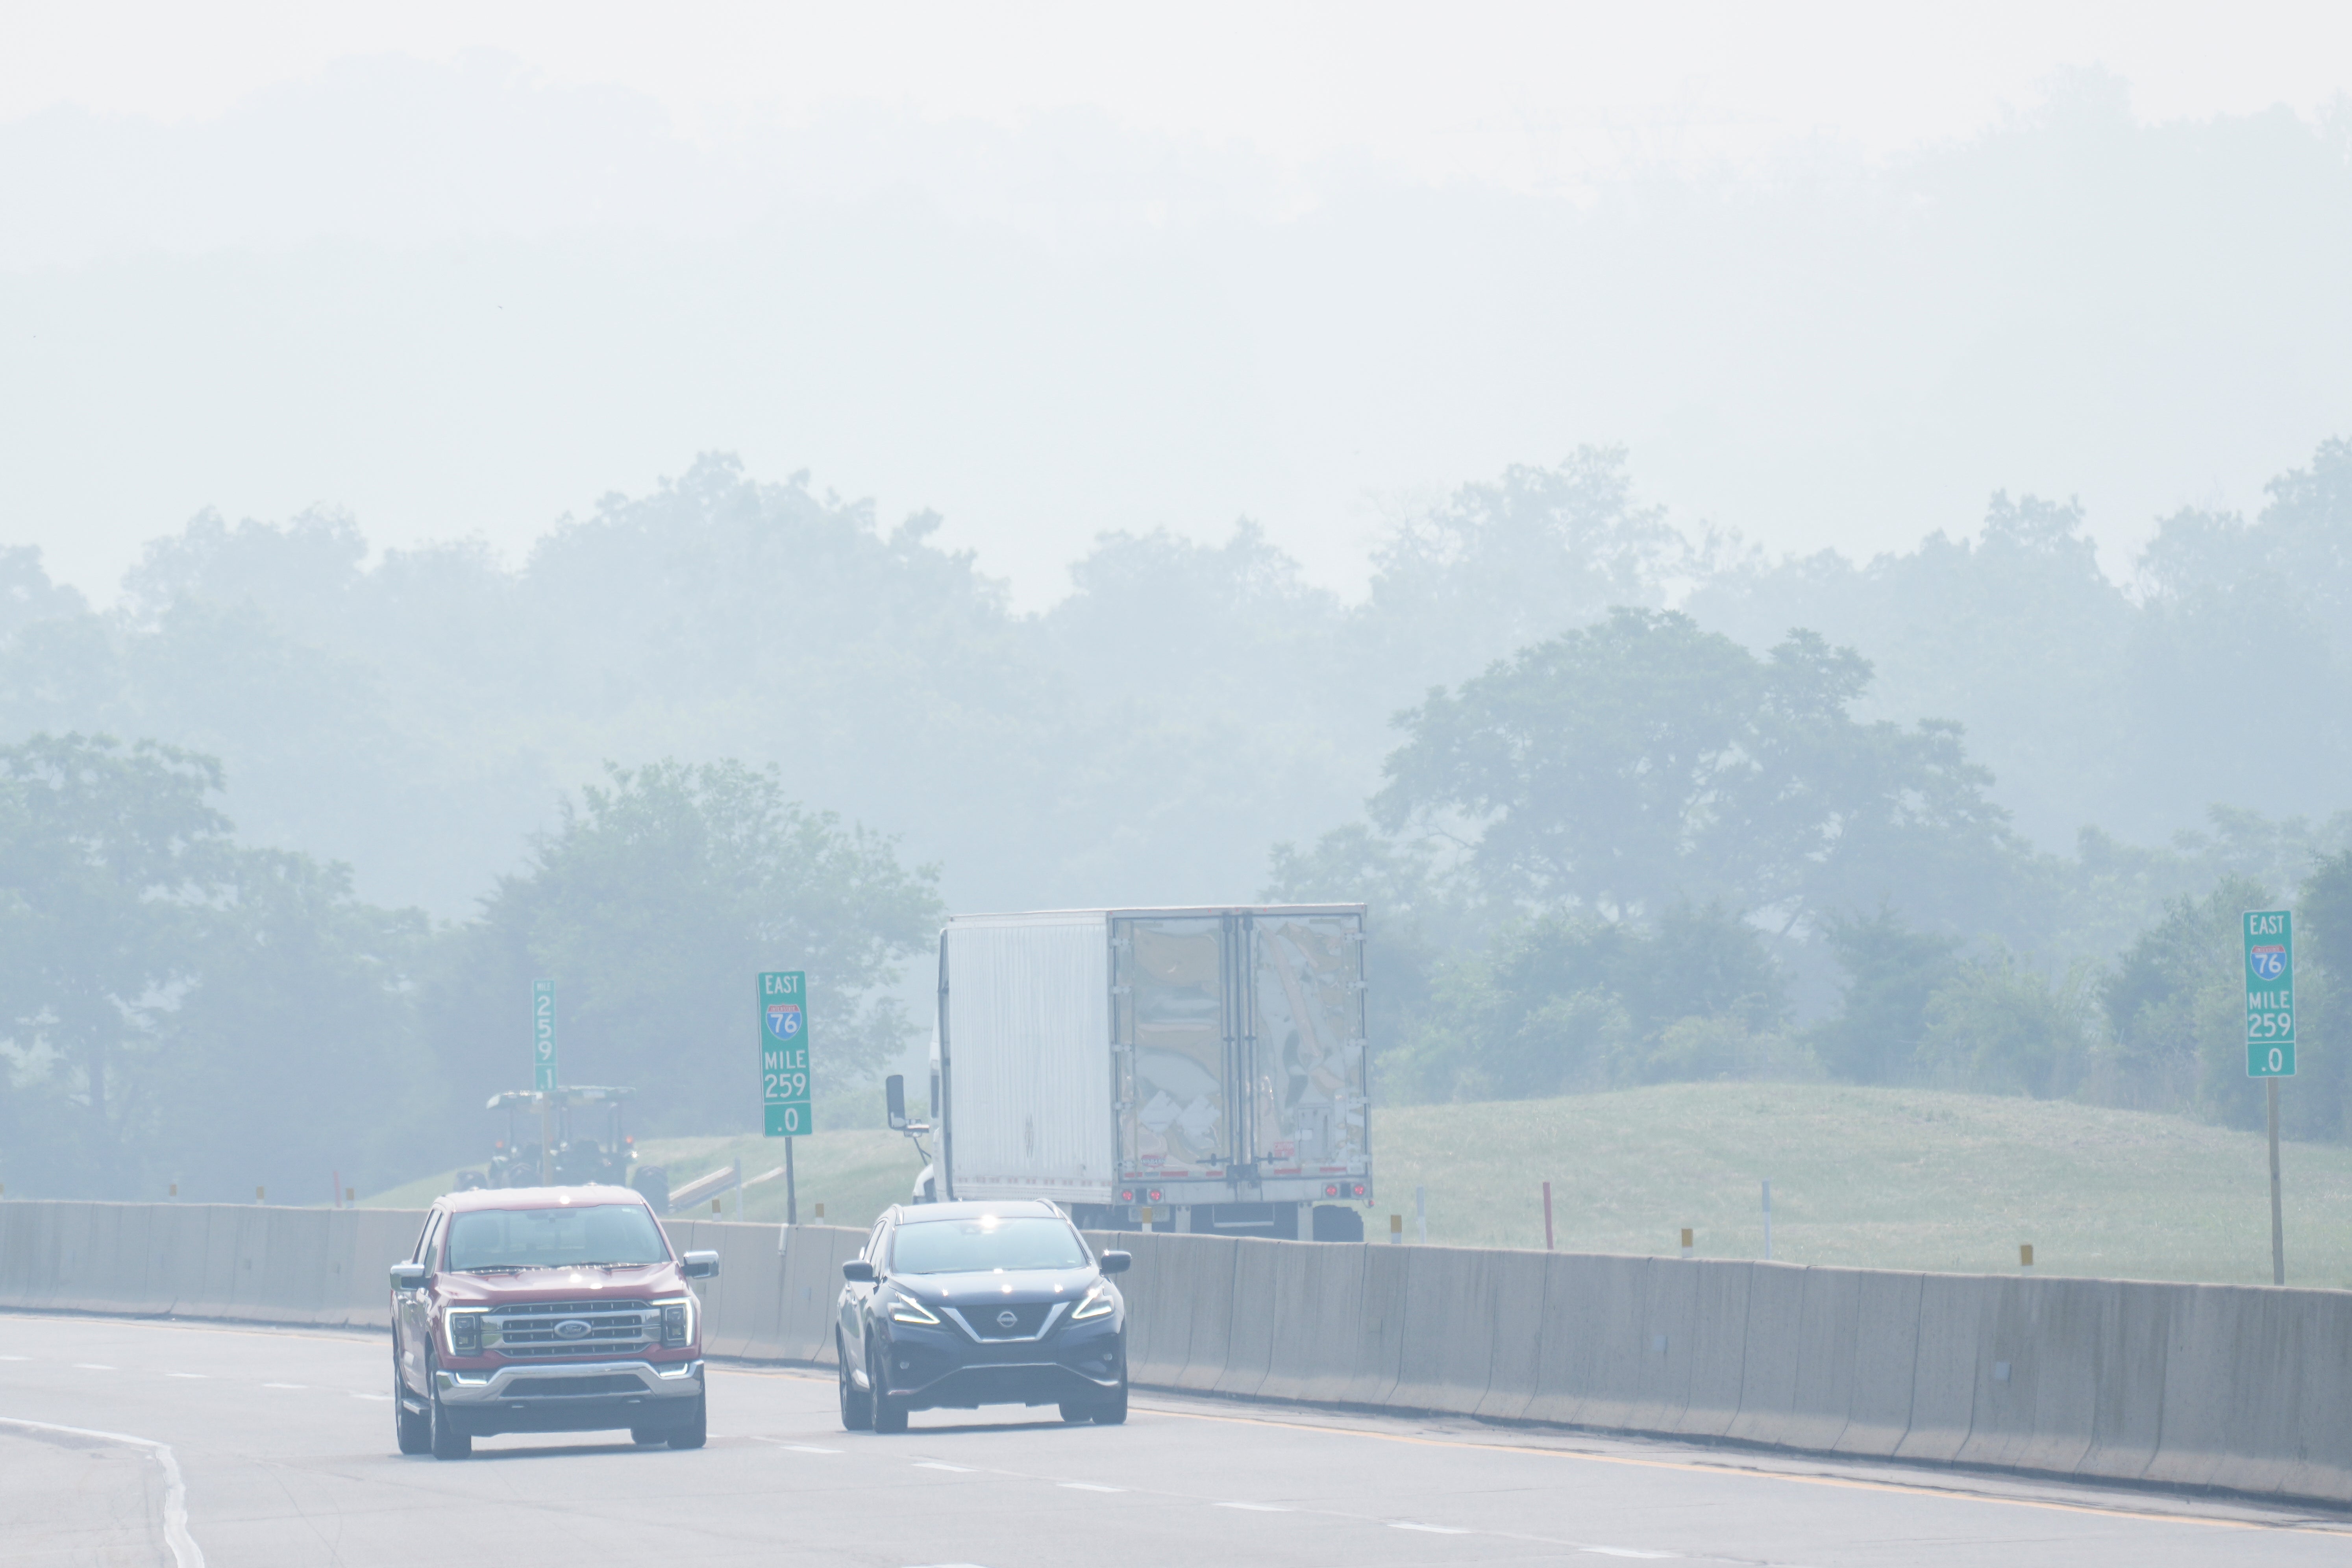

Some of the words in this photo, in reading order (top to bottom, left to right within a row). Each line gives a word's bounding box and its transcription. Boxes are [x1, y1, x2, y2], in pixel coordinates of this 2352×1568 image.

[2250, 915, 2284, 935] EAST
[2255, 954, 2281, 973] 76
[537, 983, 551, 991] MILE
[765, 975, 798, 995] EAST
[2248, 991, 2290, 1010] MILE
[770, 1013, 797, 1034] 76
[2248, 1012, 2291, 1037] 259
[765, 1050, 806, 1070] MILE
[2261, 1048, 2282, 1072] .0
[764, 1073, 806, 1098] 259
[777, 1108, 798, 1132] .0
